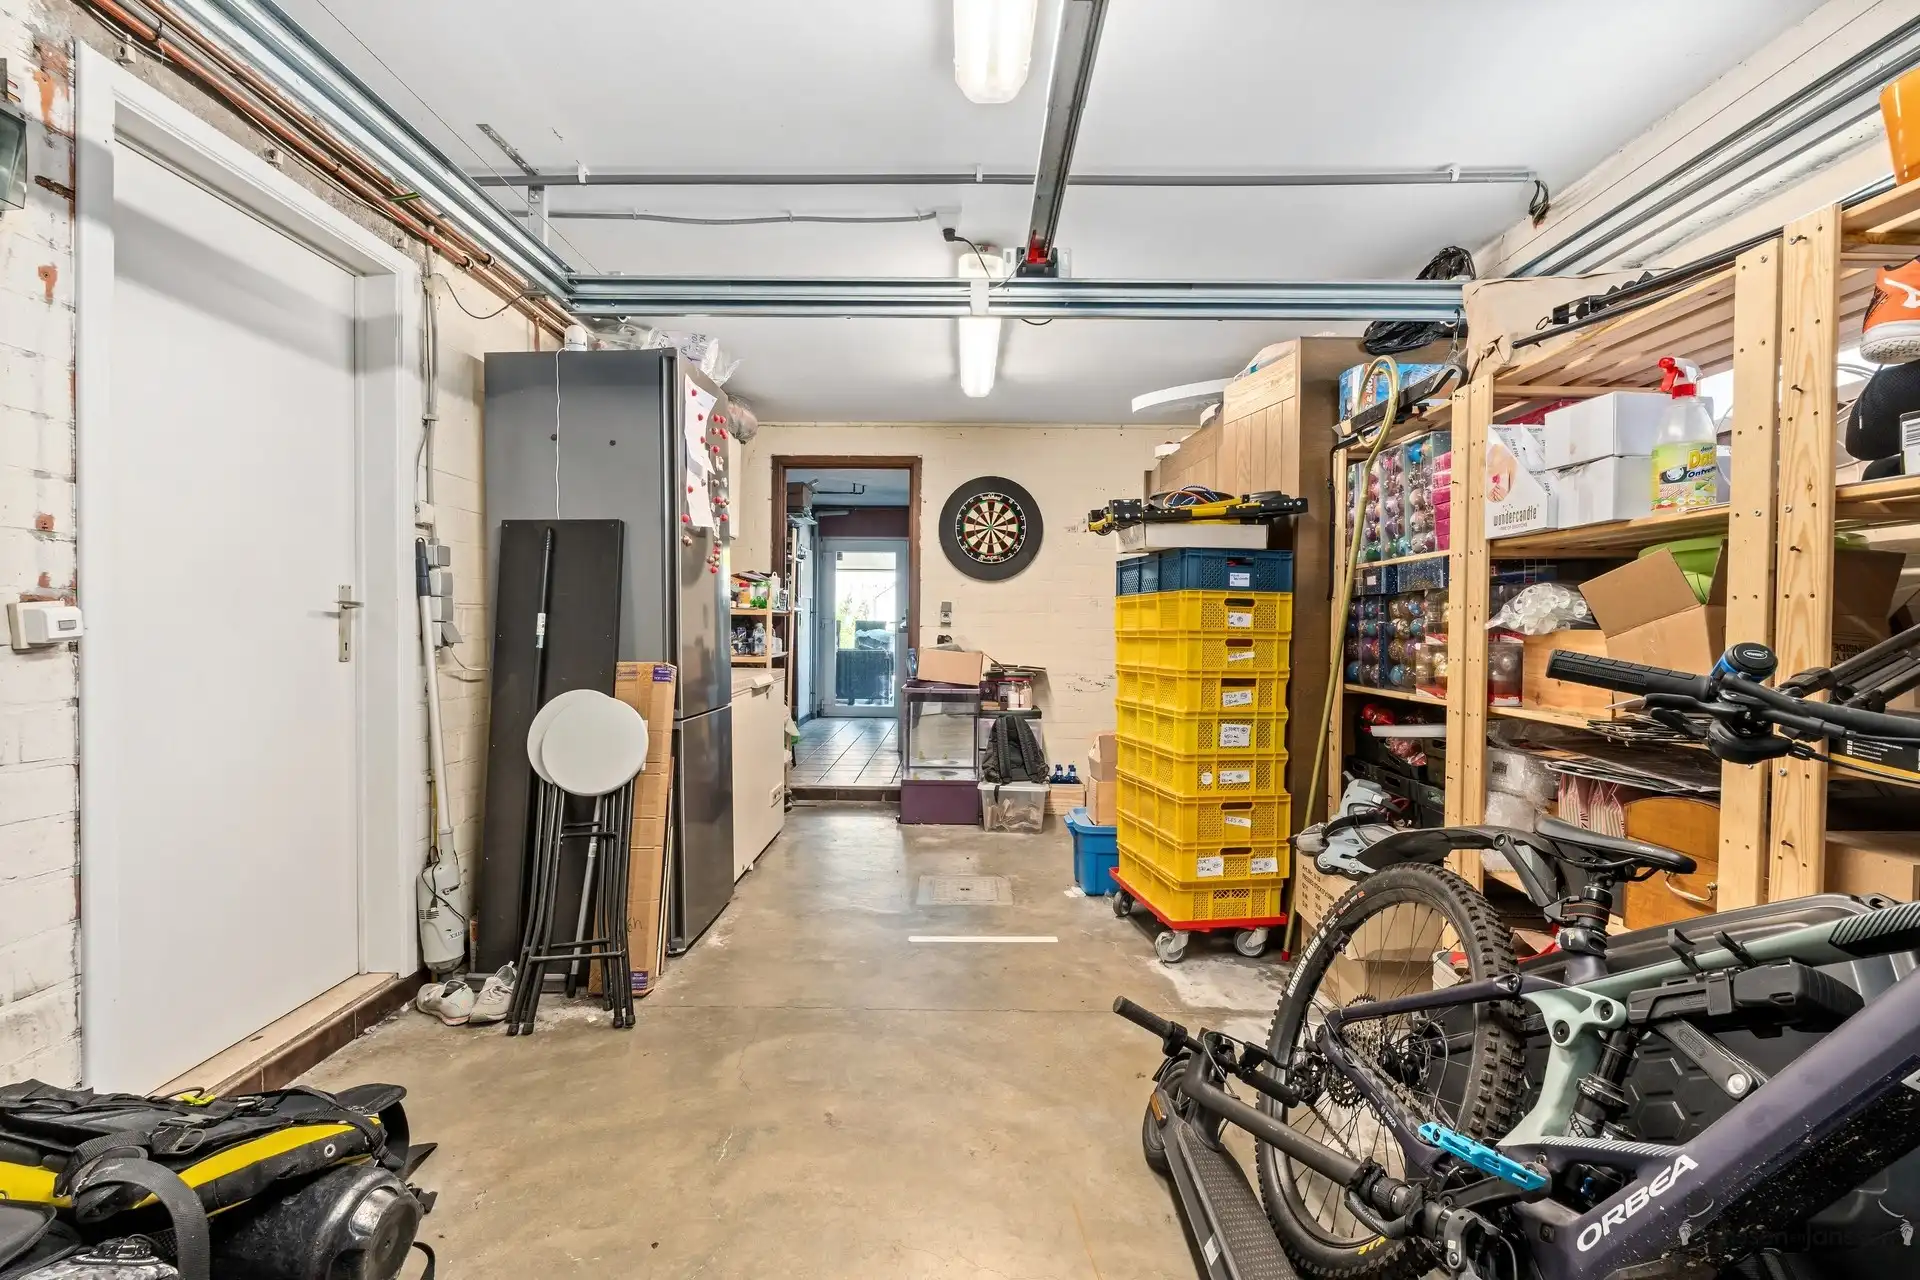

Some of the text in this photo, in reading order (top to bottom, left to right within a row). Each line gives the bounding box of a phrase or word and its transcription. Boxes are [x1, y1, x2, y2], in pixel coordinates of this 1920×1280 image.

[1493, 506, 1537, 526] wondercandle
[1286, 956, 1308, 998] MINION
[1576, 1154, 1698, 1251] ORBEA
